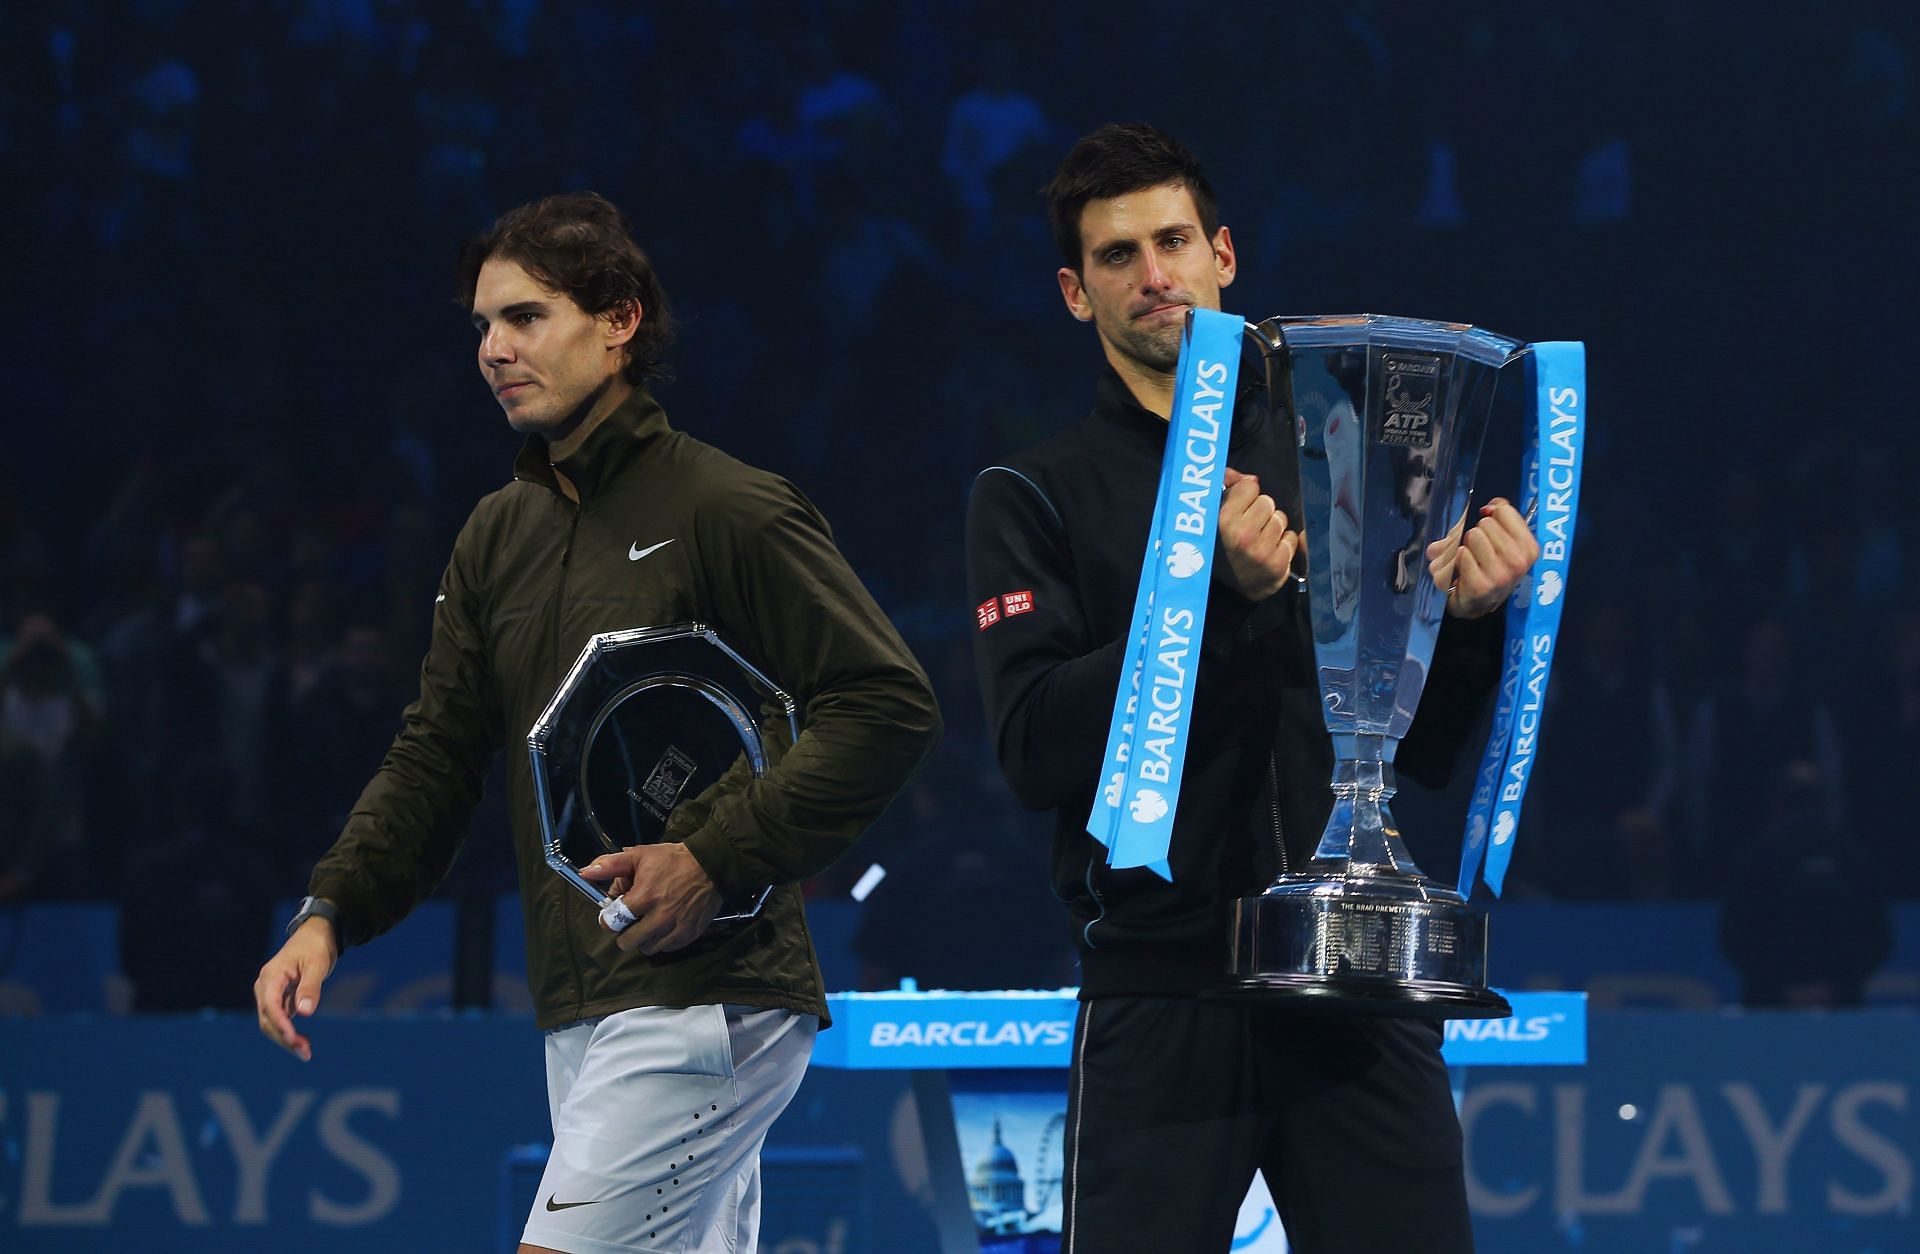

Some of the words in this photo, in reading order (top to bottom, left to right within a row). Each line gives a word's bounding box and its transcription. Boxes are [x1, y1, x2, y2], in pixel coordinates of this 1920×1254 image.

[1174, 359, 1228, 536] BARCLAYS
[1383, 413, 1429, 429] ATP
[1542, 386, 1578, 561] BARCLAYS
[1005, 594, 1027, 604] UNI
[1007, 602, 1030, 615] QLO
[1139, 607, 1194, 784] BARCLAYS
[1476, 637, 1526, 805] BARCLAYS
[1502, 633, 1551, 803] BARCLAYS
[1341, 902, 1355, 911] THE
[869, 1020, 1071, 1048] BARCLAYS
[0, 1086, 402, 1228] LAYS
